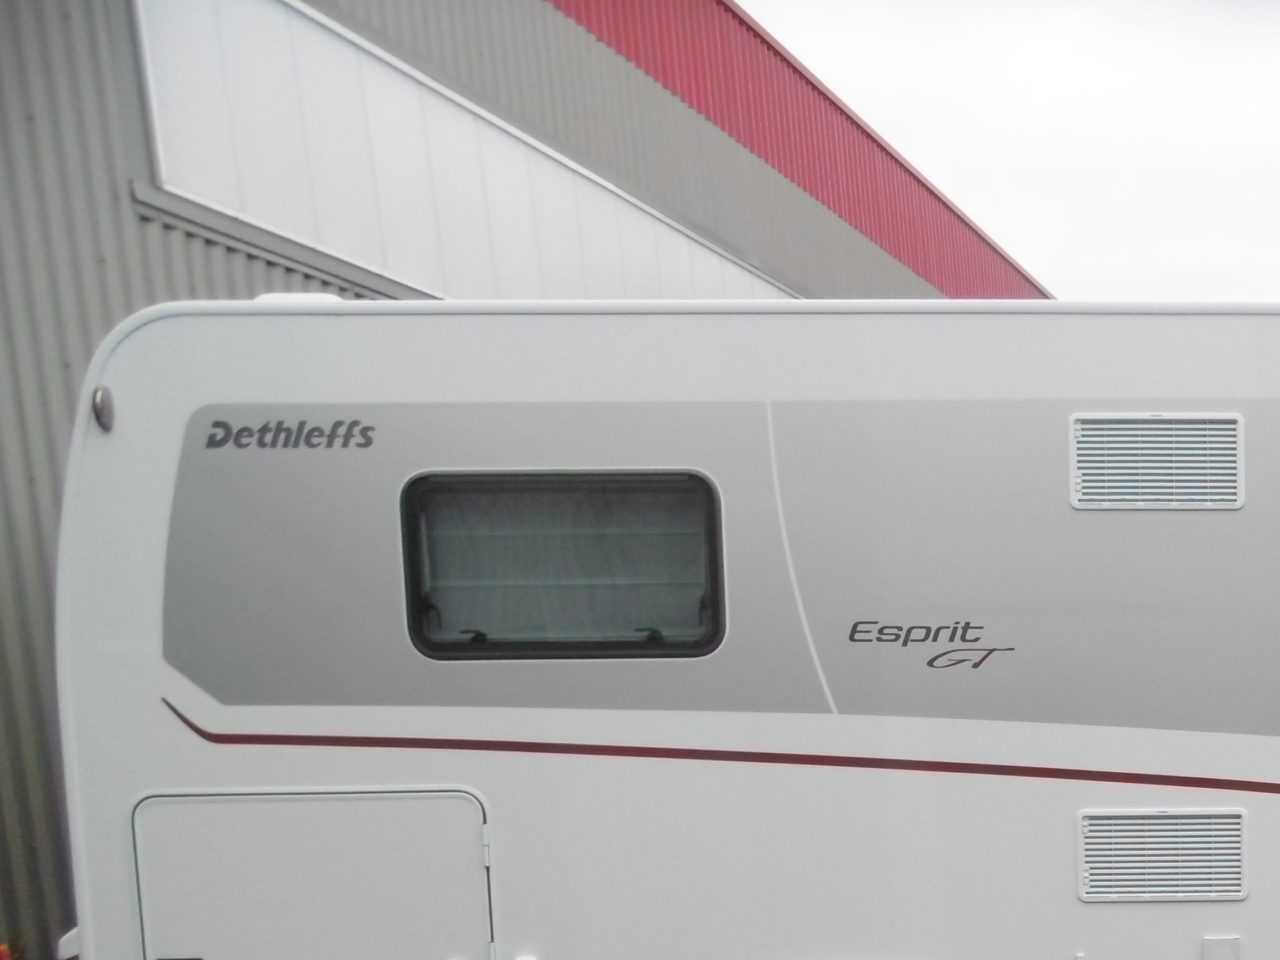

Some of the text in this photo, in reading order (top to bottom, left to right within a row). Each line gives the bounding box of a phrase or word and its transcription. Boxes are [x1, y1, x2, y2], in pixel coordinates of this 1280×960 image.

[206, 420, 376, 449] Dethleffs
[848, 621, 984, 647] Esprit
[926, 647, 1015, 669] GT
